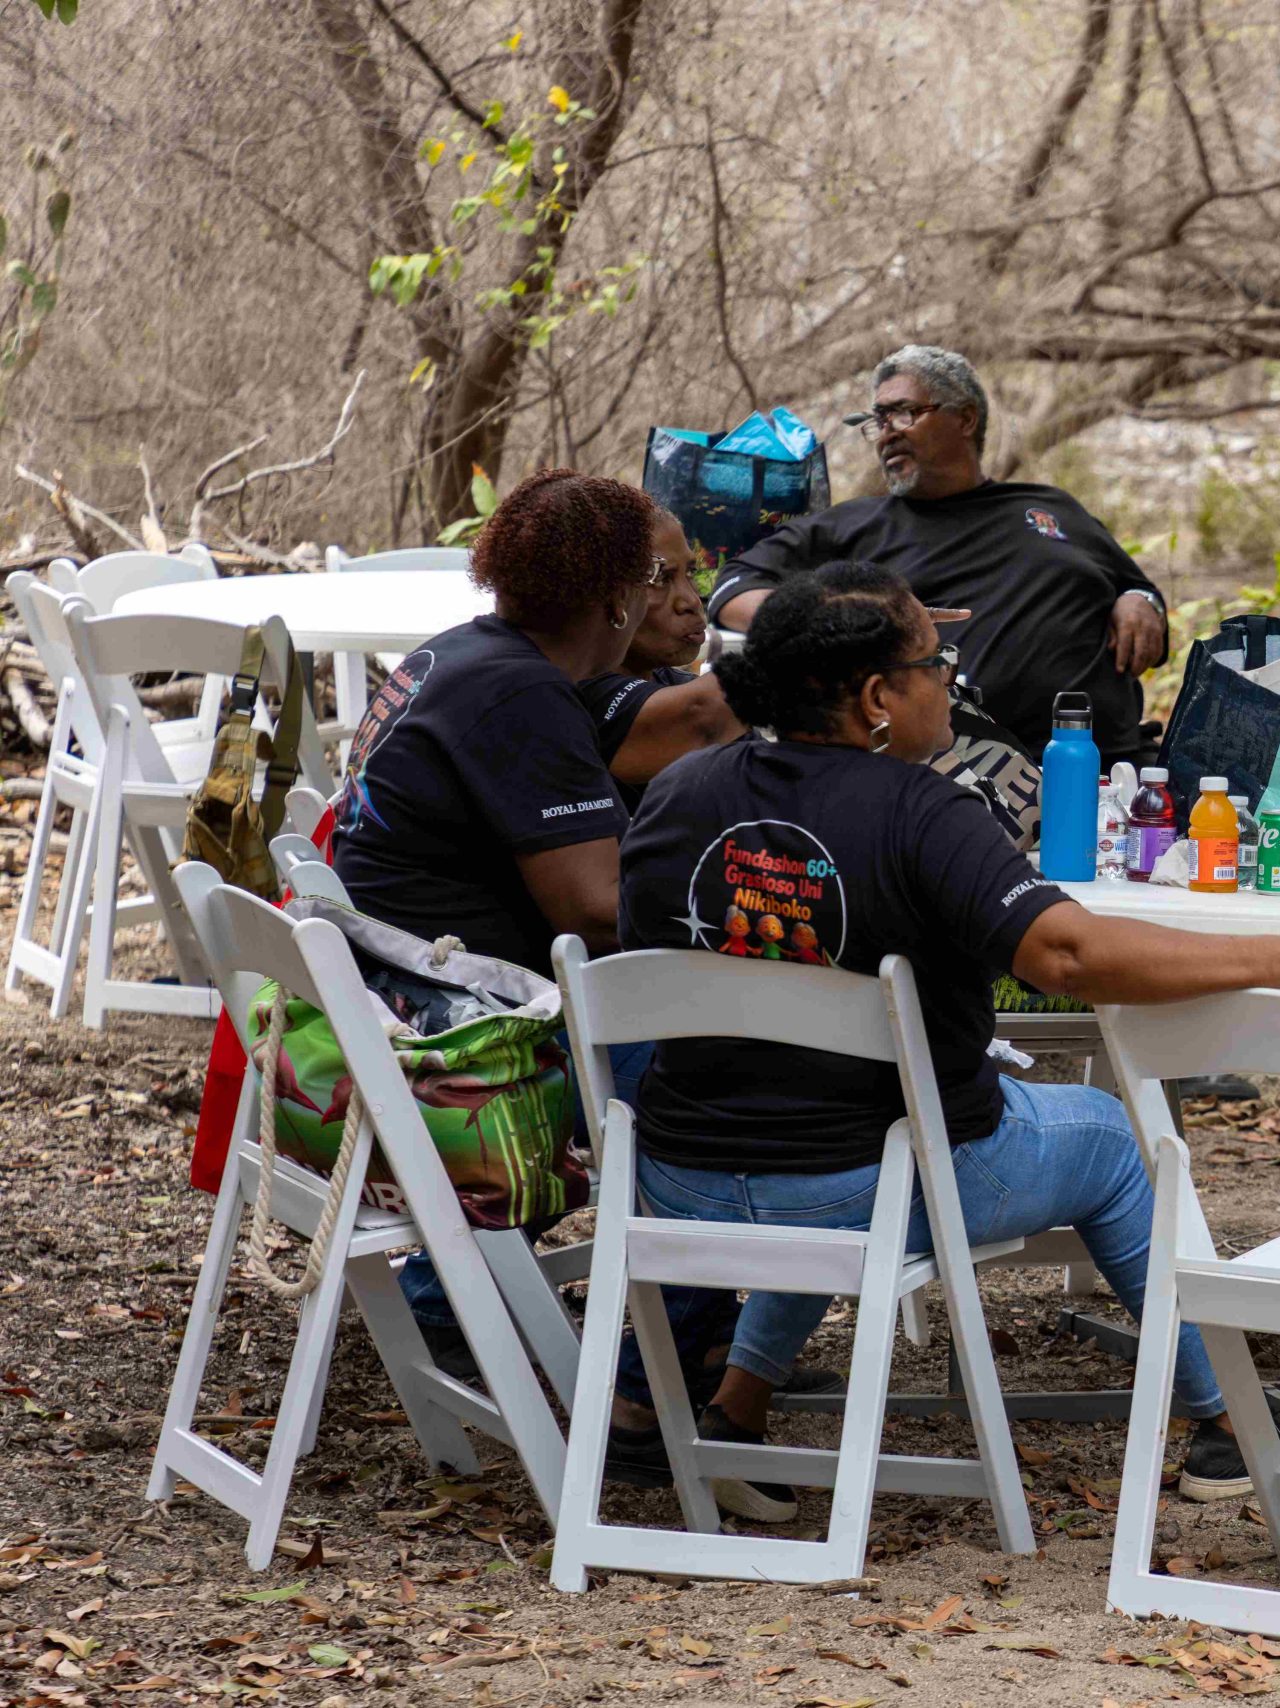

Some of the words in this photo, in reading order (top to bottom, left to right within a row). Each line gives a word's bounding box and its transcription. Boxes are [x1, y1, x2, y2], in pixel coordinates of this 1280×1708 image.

[604, 691, 627, 720] ROYAL
[541, 804, 576, 818] ROYAL
[724, 840, 806, 875] Fundashon
[806, 859, 838, 878] 60+
[725, 864, 796, 896] Grasioso
[798, 879, 823, 899] Uni
[1001, 880, 1035, 908] ROYAL
[734, 887, 811, 921] Nikiboko
